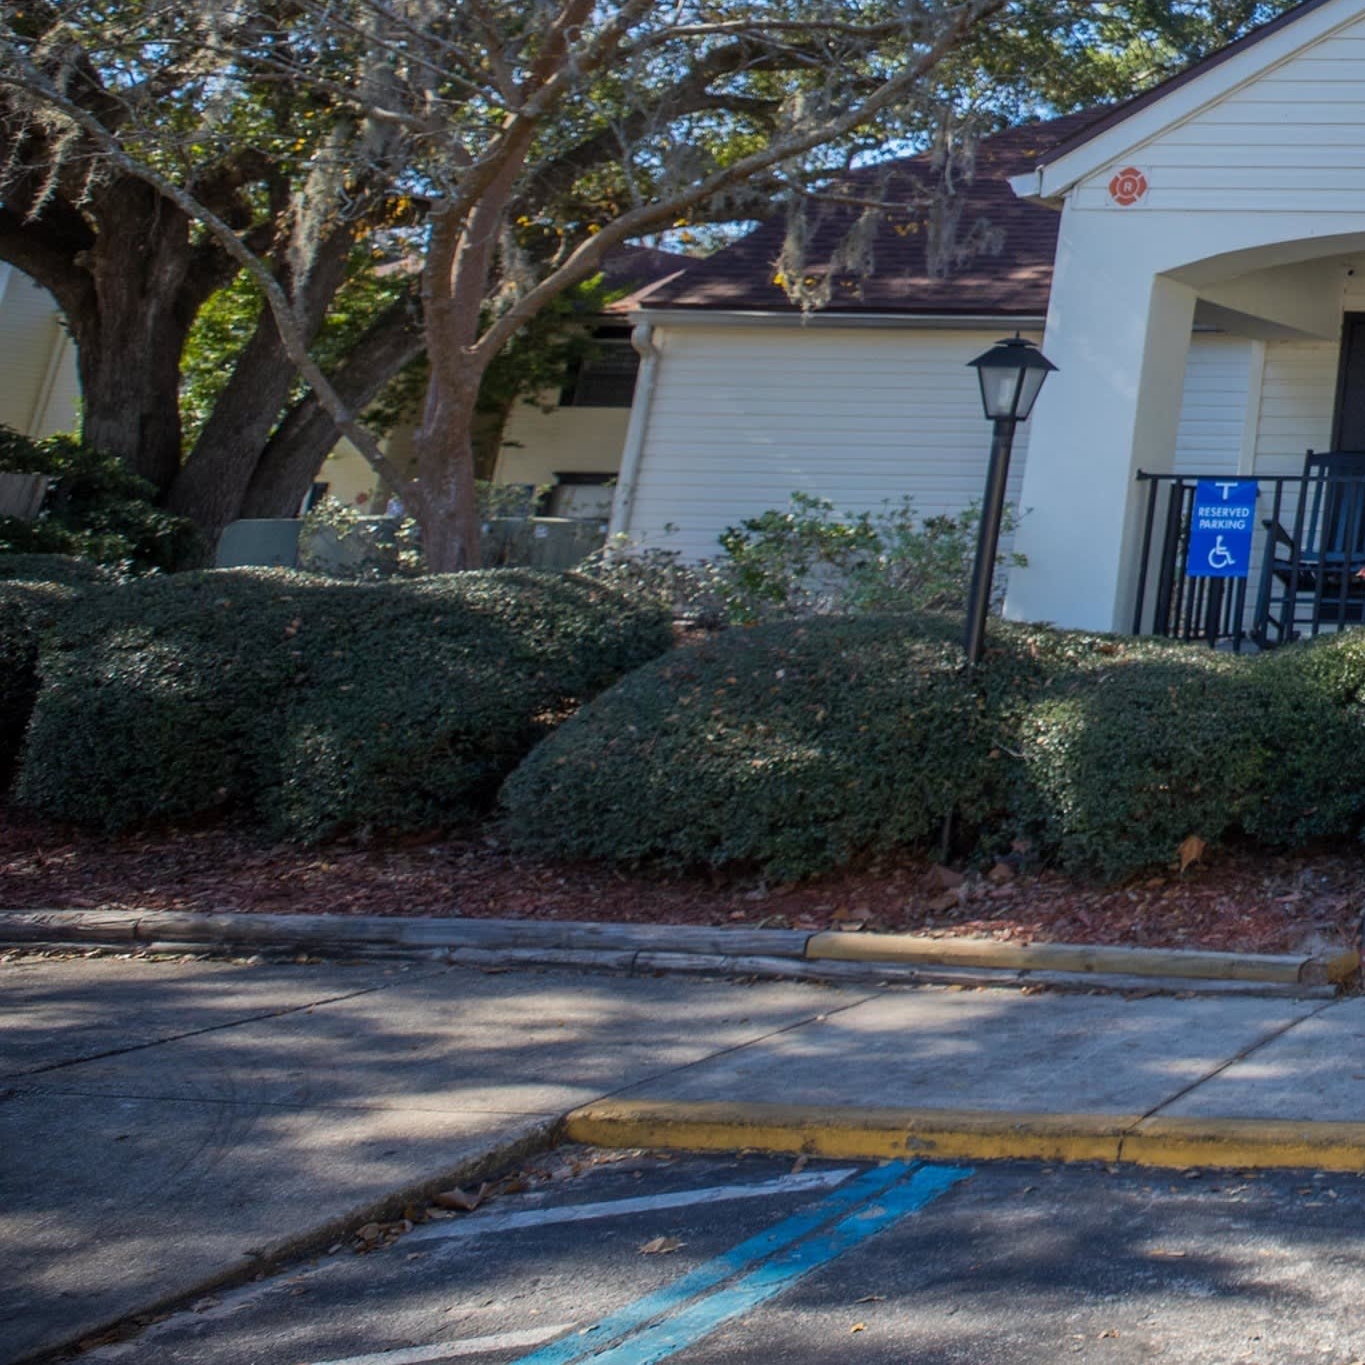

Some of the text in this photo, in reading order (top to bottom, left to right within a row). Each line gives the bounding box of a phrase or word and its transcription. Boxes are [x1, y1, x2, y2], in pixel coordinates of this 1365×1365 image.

[1215, 482, 1238, 500] T
[1198, 506, 1250, 517] RESERVED
[1199, 519, 1246, 530] PARKING
